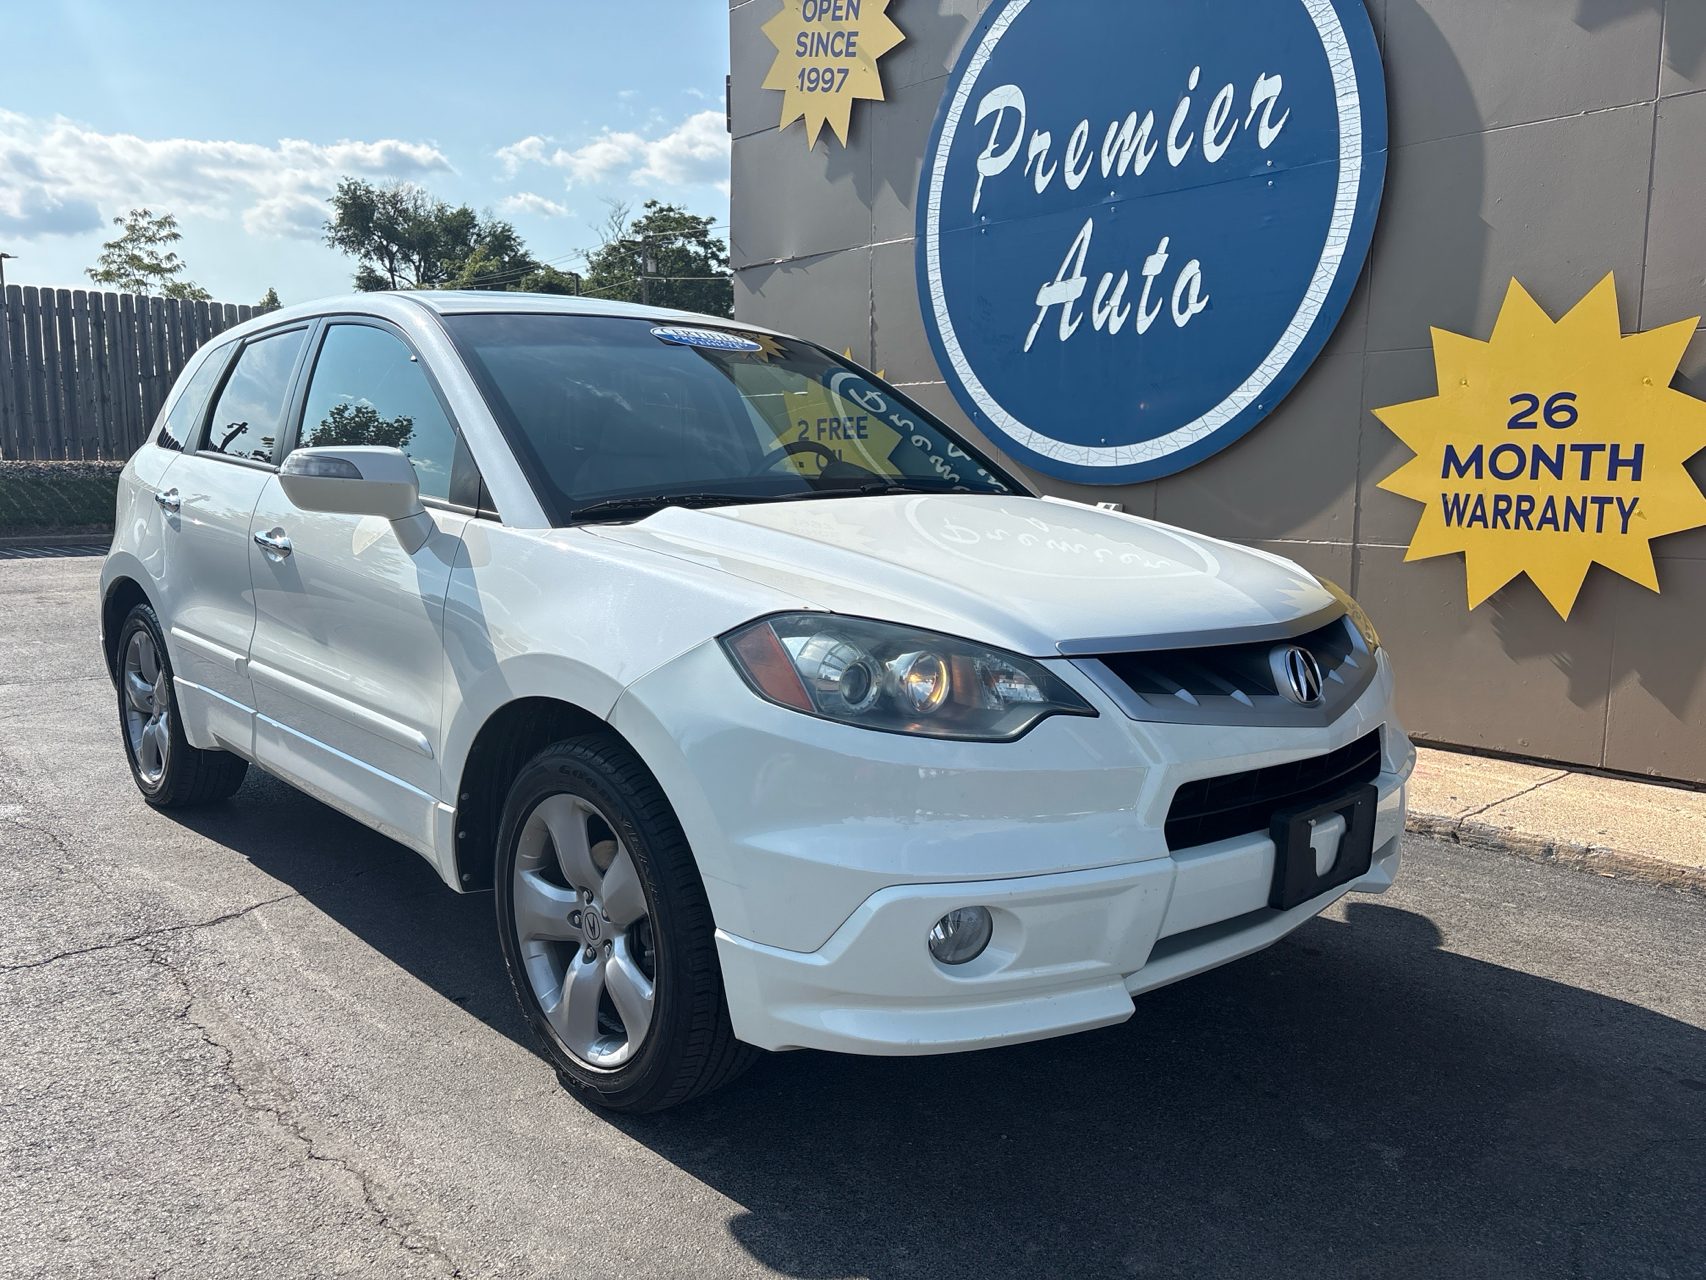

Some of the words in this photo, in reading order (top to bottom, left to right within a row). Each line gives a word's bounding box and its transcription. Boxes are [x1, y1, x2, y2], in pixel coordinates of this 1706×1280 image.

[802, 0, 860, 22] OPEN
[795, 31, 859, 58] SINCE
[798, 67, 849, 93] 1997
[973, 66, 1290, 213] Premier
[1024, 217, 1209, 352] Auto
[798, 419, 809, 441] 2
[816, 416, 868, 441] FREE
[1507, 392, 1578, 429] 26
[1441, 443, 1645, 482] MONTH
[1441, 493, 1639, 534] WARRANTY
